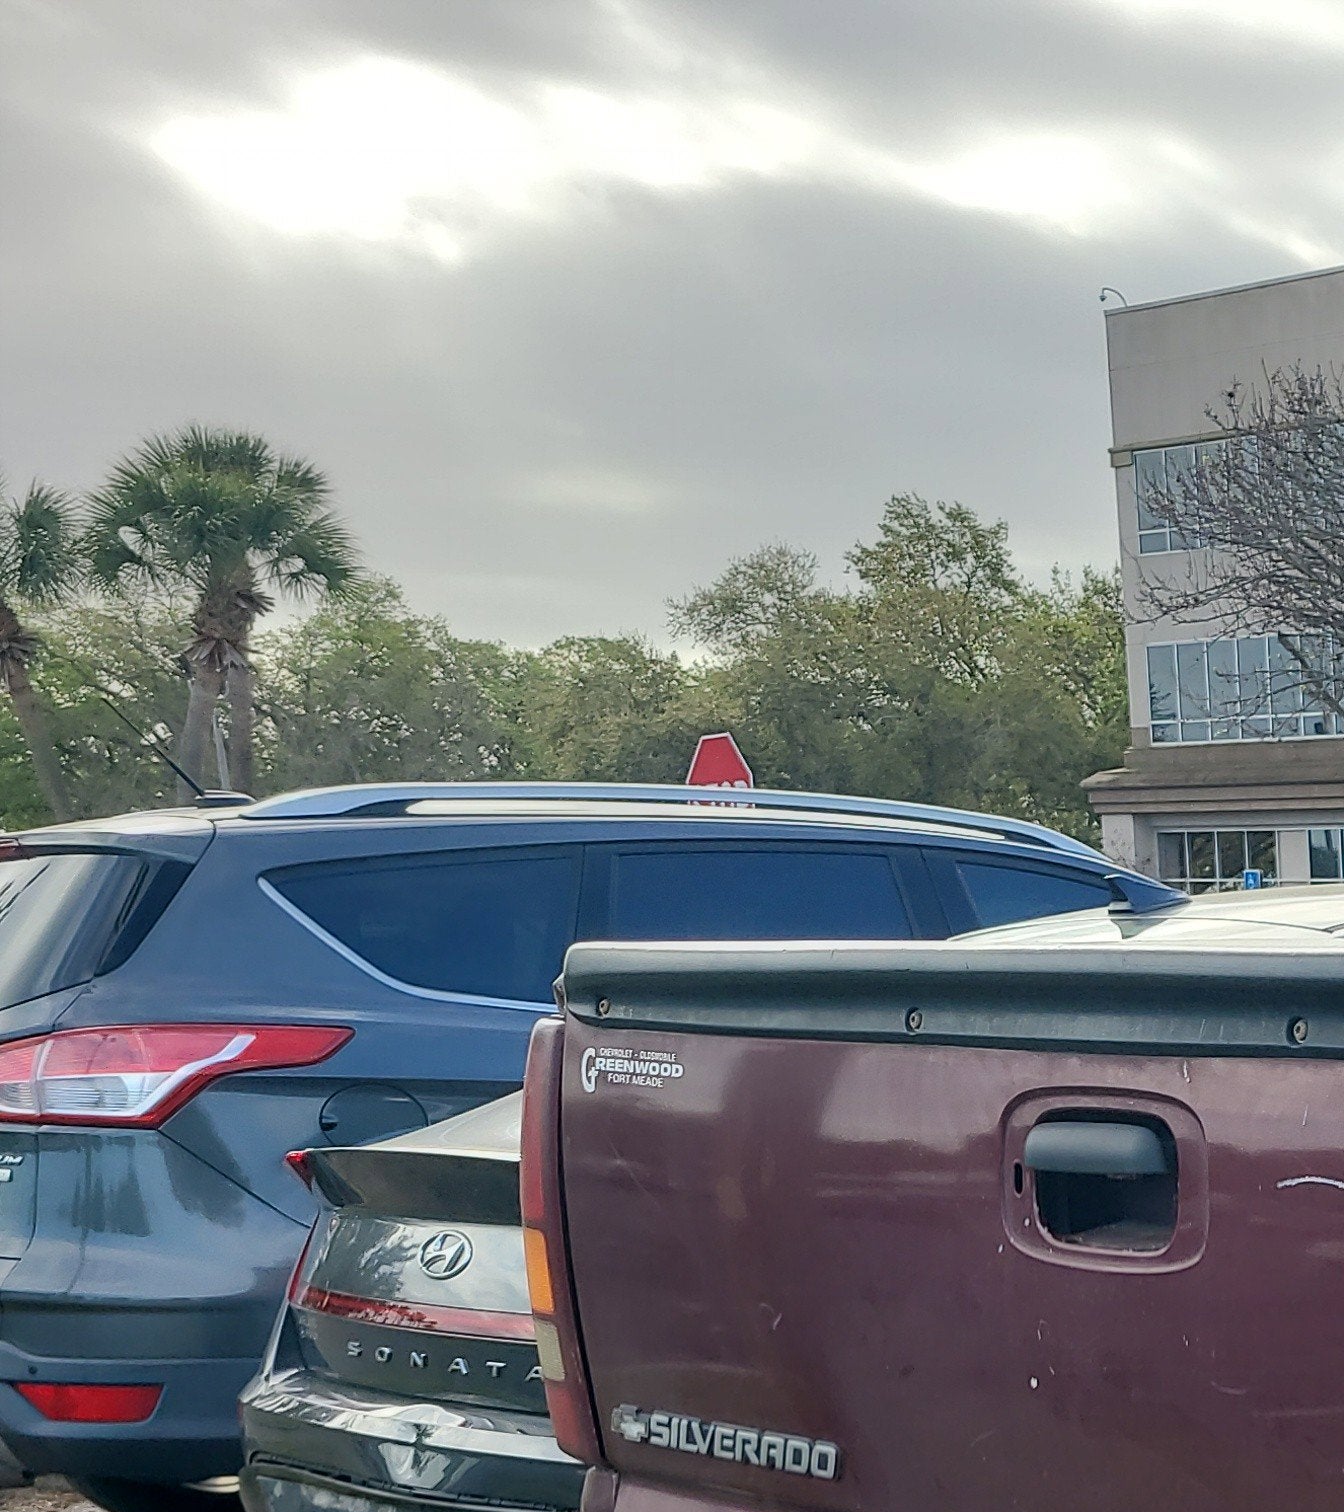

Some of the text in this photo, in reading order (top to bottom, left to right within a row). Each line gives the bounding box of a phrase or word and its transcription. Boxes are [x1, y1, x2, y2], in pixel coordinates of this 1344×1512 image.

[581, 1047, 684, 1093] GREENWOOD
[600, 1047, 633, 1058] CHEVROLET
[640, 1050, 677, 1062] OLDSMOBILE
[607, 1072, 664, 1088] FORT MEADE
[347, 1340, 544, 1382] SONATA
[648, 1410, 841, 1481] SILVERADO
